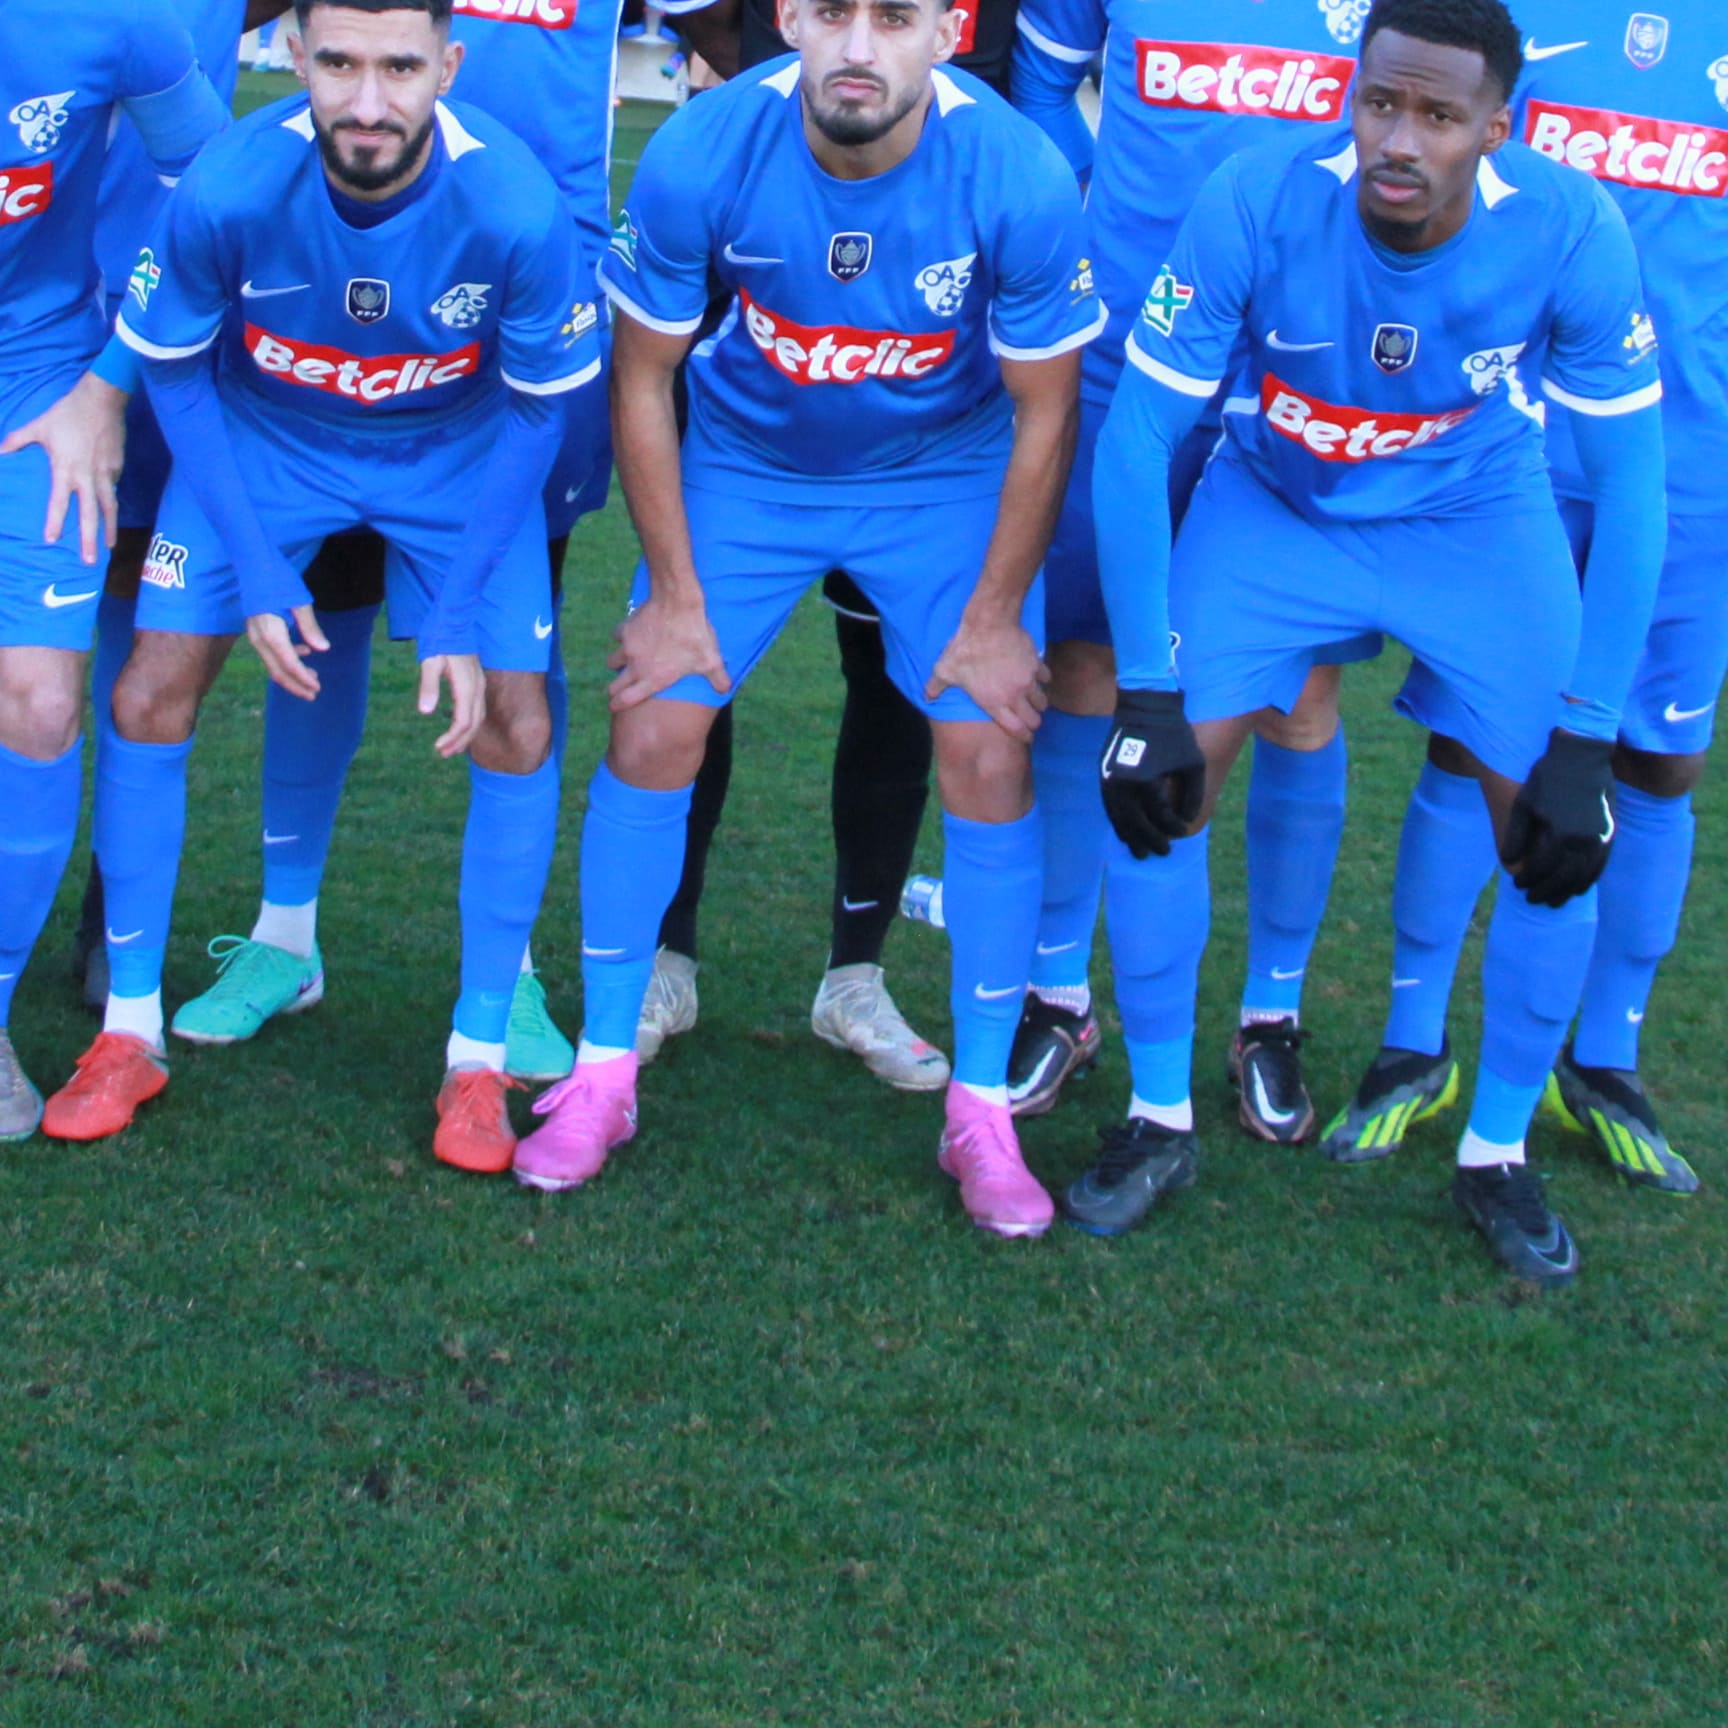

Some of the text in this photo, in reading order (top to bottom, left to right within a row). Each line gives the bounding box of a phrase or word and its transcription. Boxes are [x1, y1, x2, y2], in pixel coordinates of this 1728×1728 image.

[1144, 50, 1339, 116] Betclic
[17, 100, 69, 127] OAC
[1530, 110, 1727, 191] Betclic
[438, 286, 489, 310] OAC
[922, 264, 972, 290] OAC
[251, 333, 473, 401] Betclic
